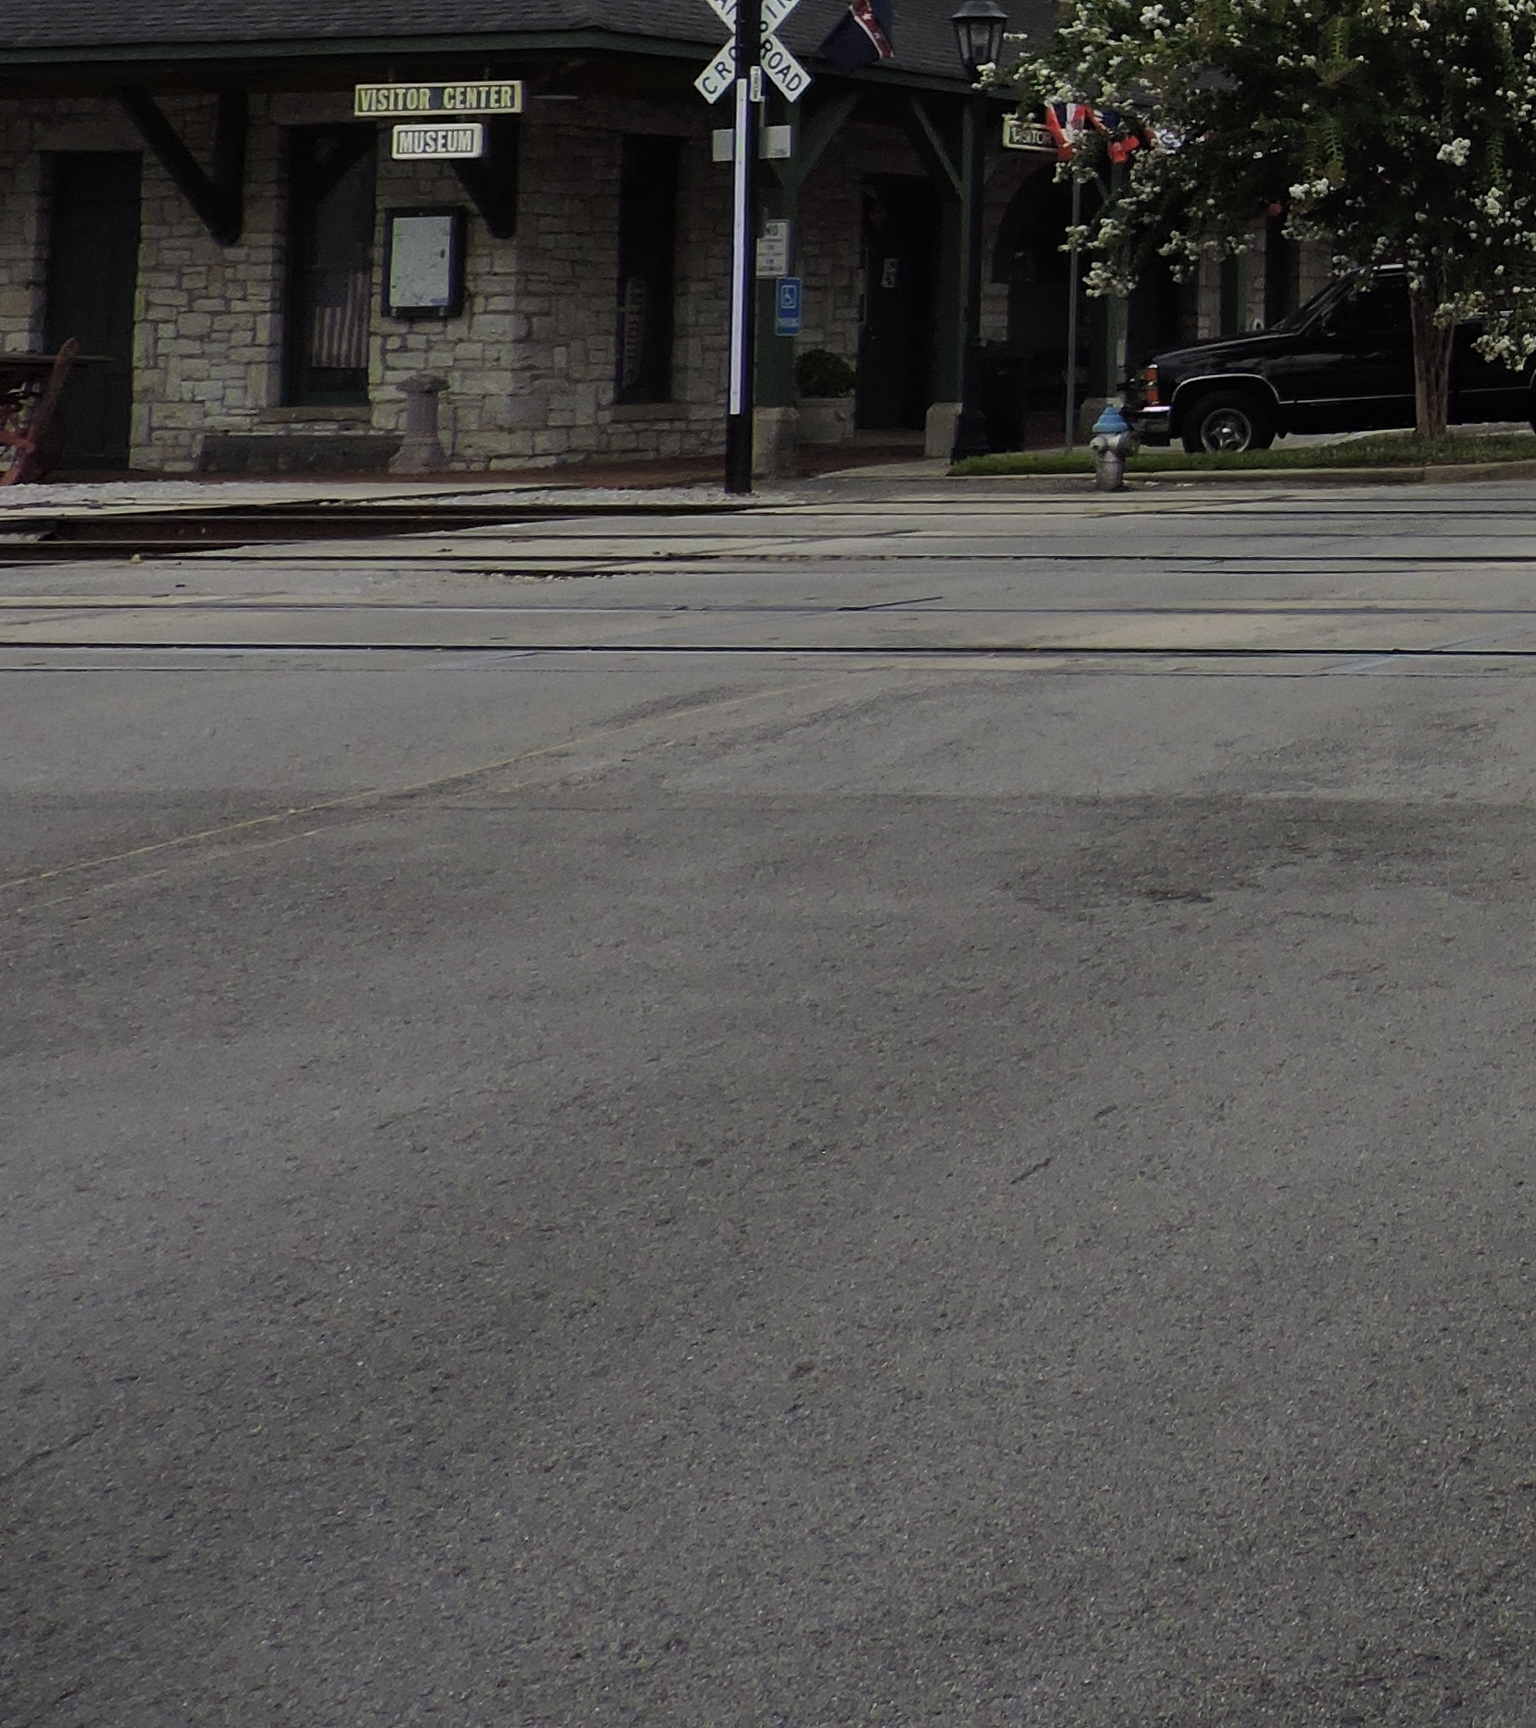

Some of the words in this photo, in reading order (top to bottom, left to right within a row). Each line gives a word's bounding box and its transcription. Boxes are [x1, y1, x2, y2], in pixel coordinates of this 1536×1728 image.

[361, 88, 430, 111] VISITOR
[443, 85, 512, 109] CENTER
[399, 129, 473, 153] MUSEUM
